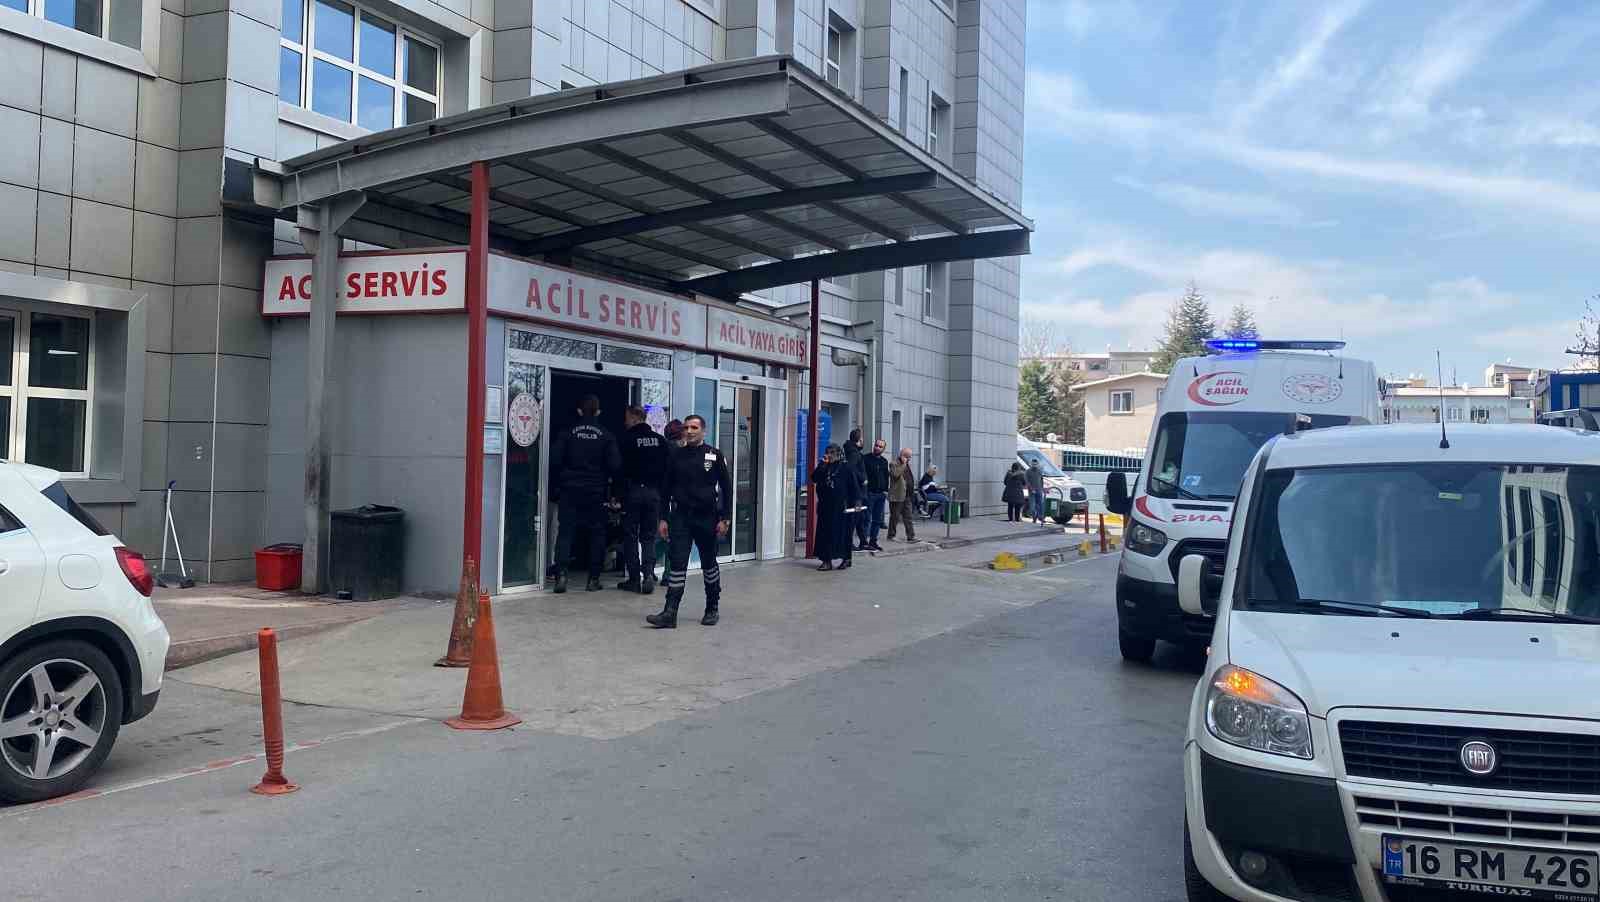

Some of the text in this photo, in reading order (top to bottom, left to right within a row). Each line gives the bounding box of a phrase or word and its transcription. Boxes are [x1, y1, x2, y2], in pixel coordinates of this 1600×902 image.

[346, 262, 447, 298] SERVİS
[526, 278, 681, 336] ACİL SERVİS
[720, 320, 746, 345] ACİL
[749, 329, 775, 353] YAYA
[1469, 750, 1489, 768] FIAT
[1389, 859, 1402, 870] TR
[1406, 844, 1591, 889] 16 RM 426
[1446, 881, 1532, 897] TURKUAZ
